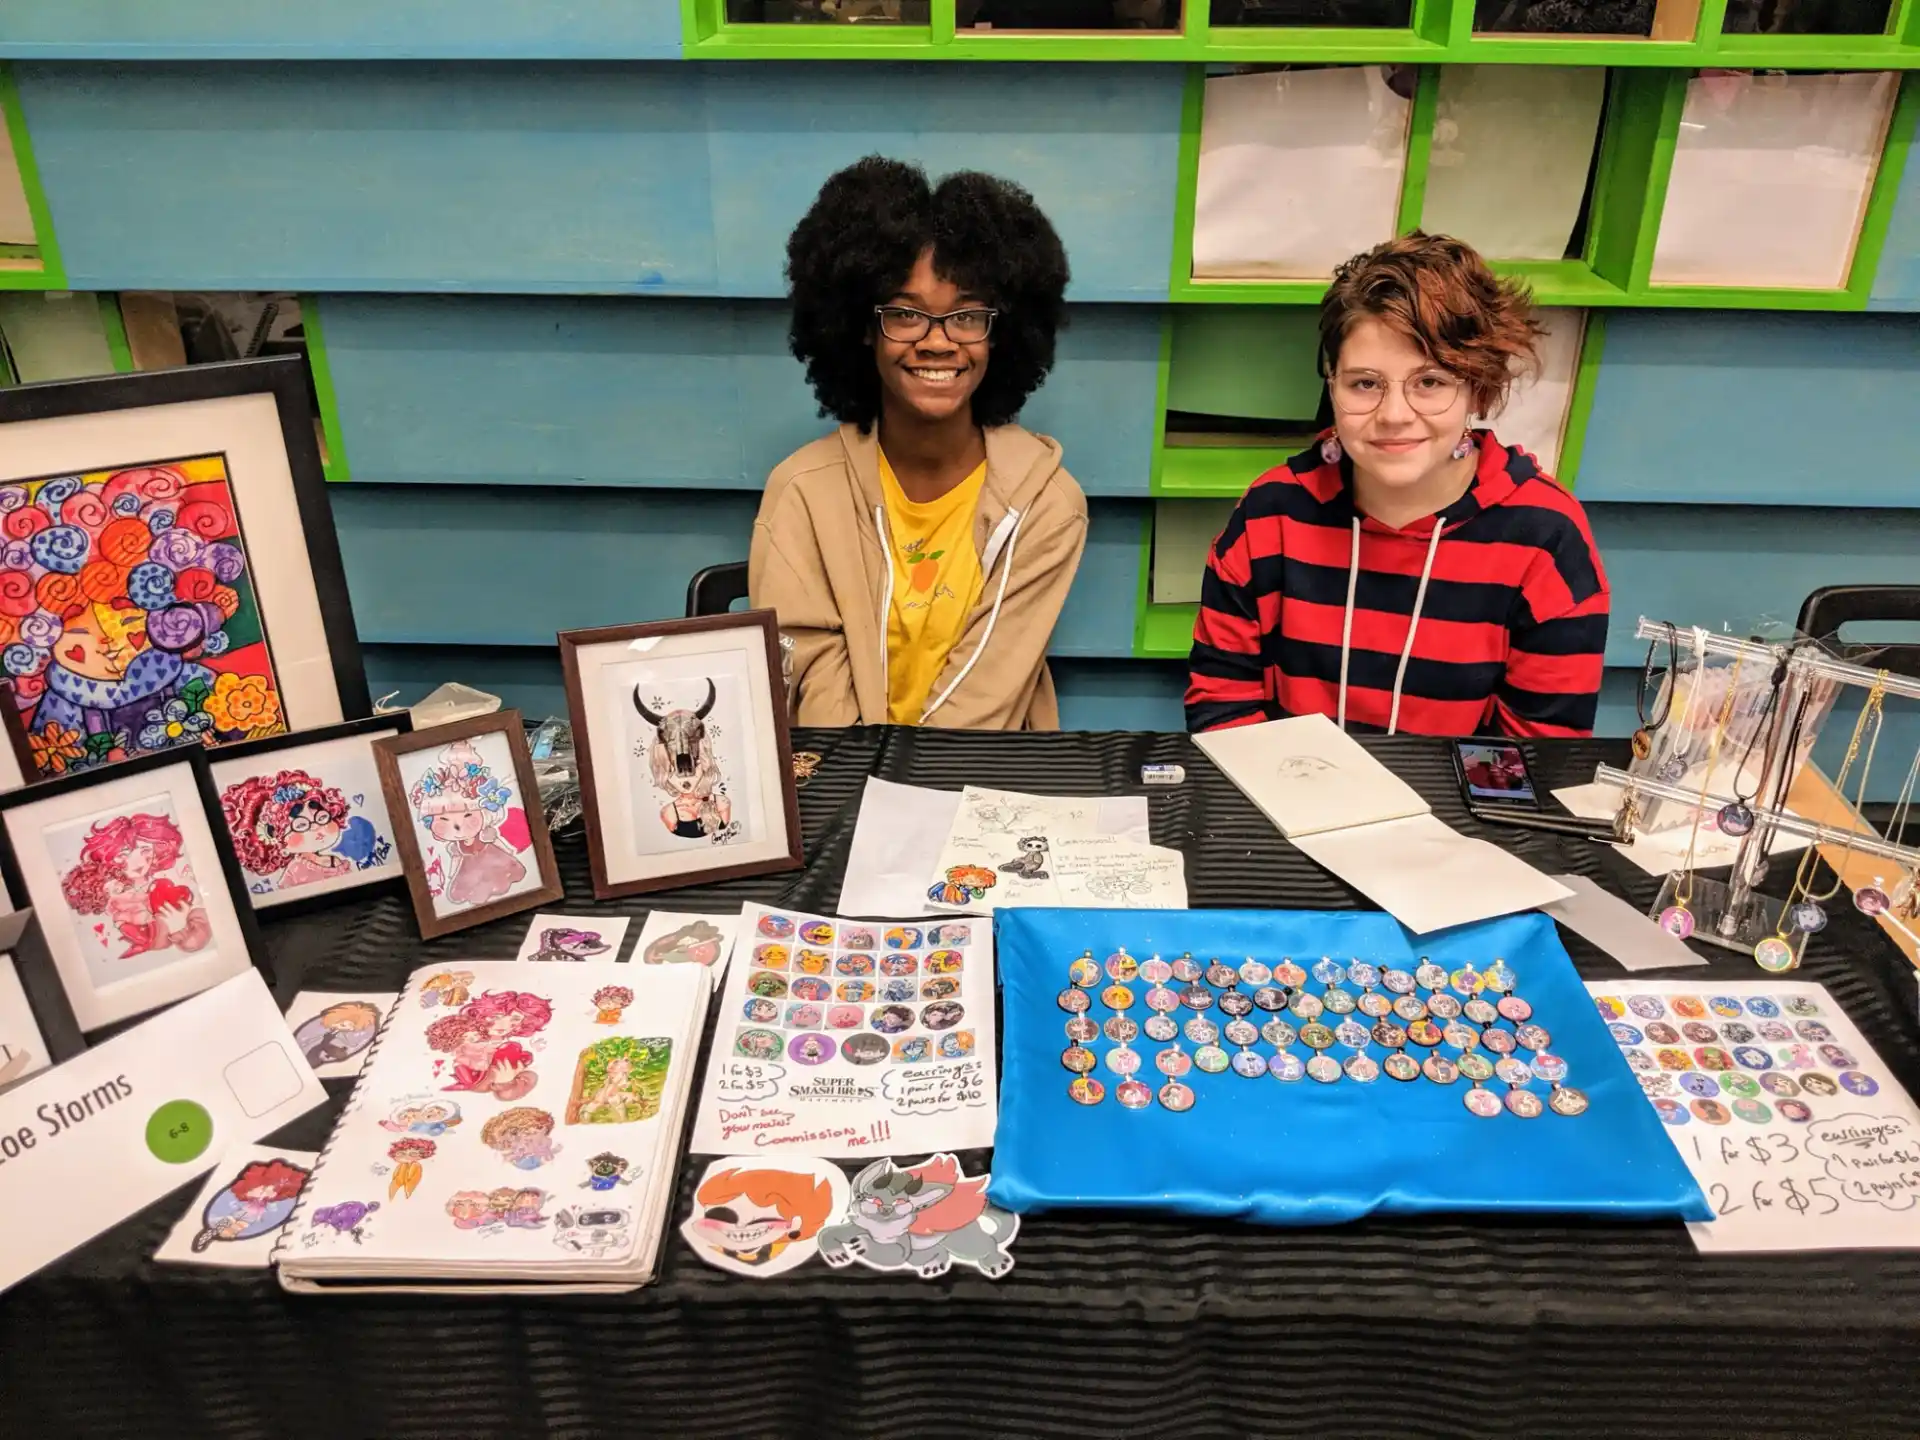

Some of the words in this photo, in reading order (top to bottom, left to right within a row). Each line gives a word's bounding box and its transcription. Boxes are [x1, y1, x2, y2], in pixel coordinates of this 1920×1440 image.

[745, 1065, 763, 1078] $3
[719, 1080, 729, 1090] 2
[745, 1080, 768, 1090] $5
[812, 1076, 856, 1087] SUPER
[958, 1073, 983, 1089] $6
[788, 1085, 835, 1097] SMASH
[896, 1097, 905, 1107] 2
[956, 1090, 981, 1102] $10
[0, 1126, 37, 1164] oe
[37, 1074, 133, 1137] Storms
[168, 1122, 190, 1139] 6-8
[722, 1123, 750, 1140] your
[754, 1127, 856, 1147] Commission
[848, 1119, 892, 1148] me!!!
[1692, 1136, 1702, 1161] 1
[1720, 1137, 1739, 1164] for
[1746, 1133, 1799, 1166] $3
[1710, 1182, 1743, 1216] 2
[1752, 1180, 1773, 1211] for
[1779, 1176, 1840, 1215] $5
[1853, 1180, 1871, 1195] 2
